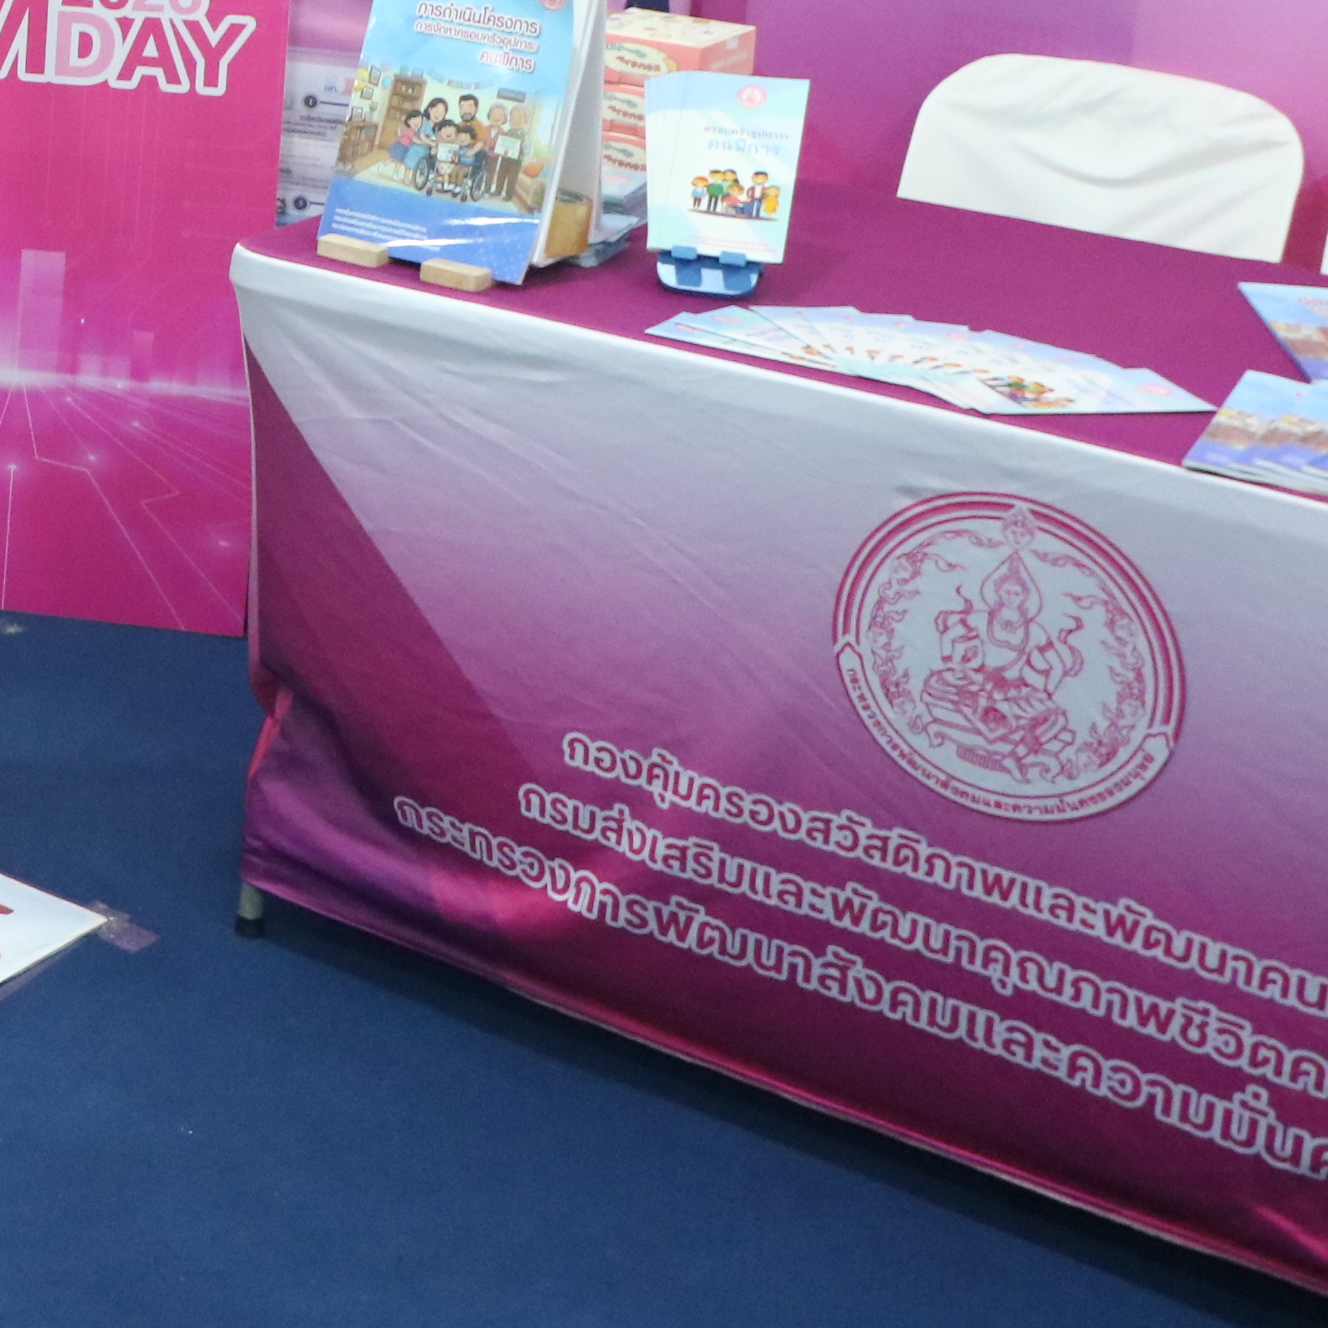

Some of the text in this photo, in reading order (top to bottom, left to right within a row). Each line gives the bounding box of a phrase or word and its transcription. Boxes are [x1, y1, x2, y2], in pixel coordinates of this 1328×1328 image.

[53, 10, 256, 96] DAY
[417, 0, 539, 35] การดำเนินโครงการ
[480, 49, 534, 71] คนพิการ
[564, 732, 1328, 1016] กองคุ้มครองสวัสดิภาพและพัฒนาคน
[519, 782, 1328, 1098] กรมส่งเสริมและพัฒนาคุณภาพชีวิตค
